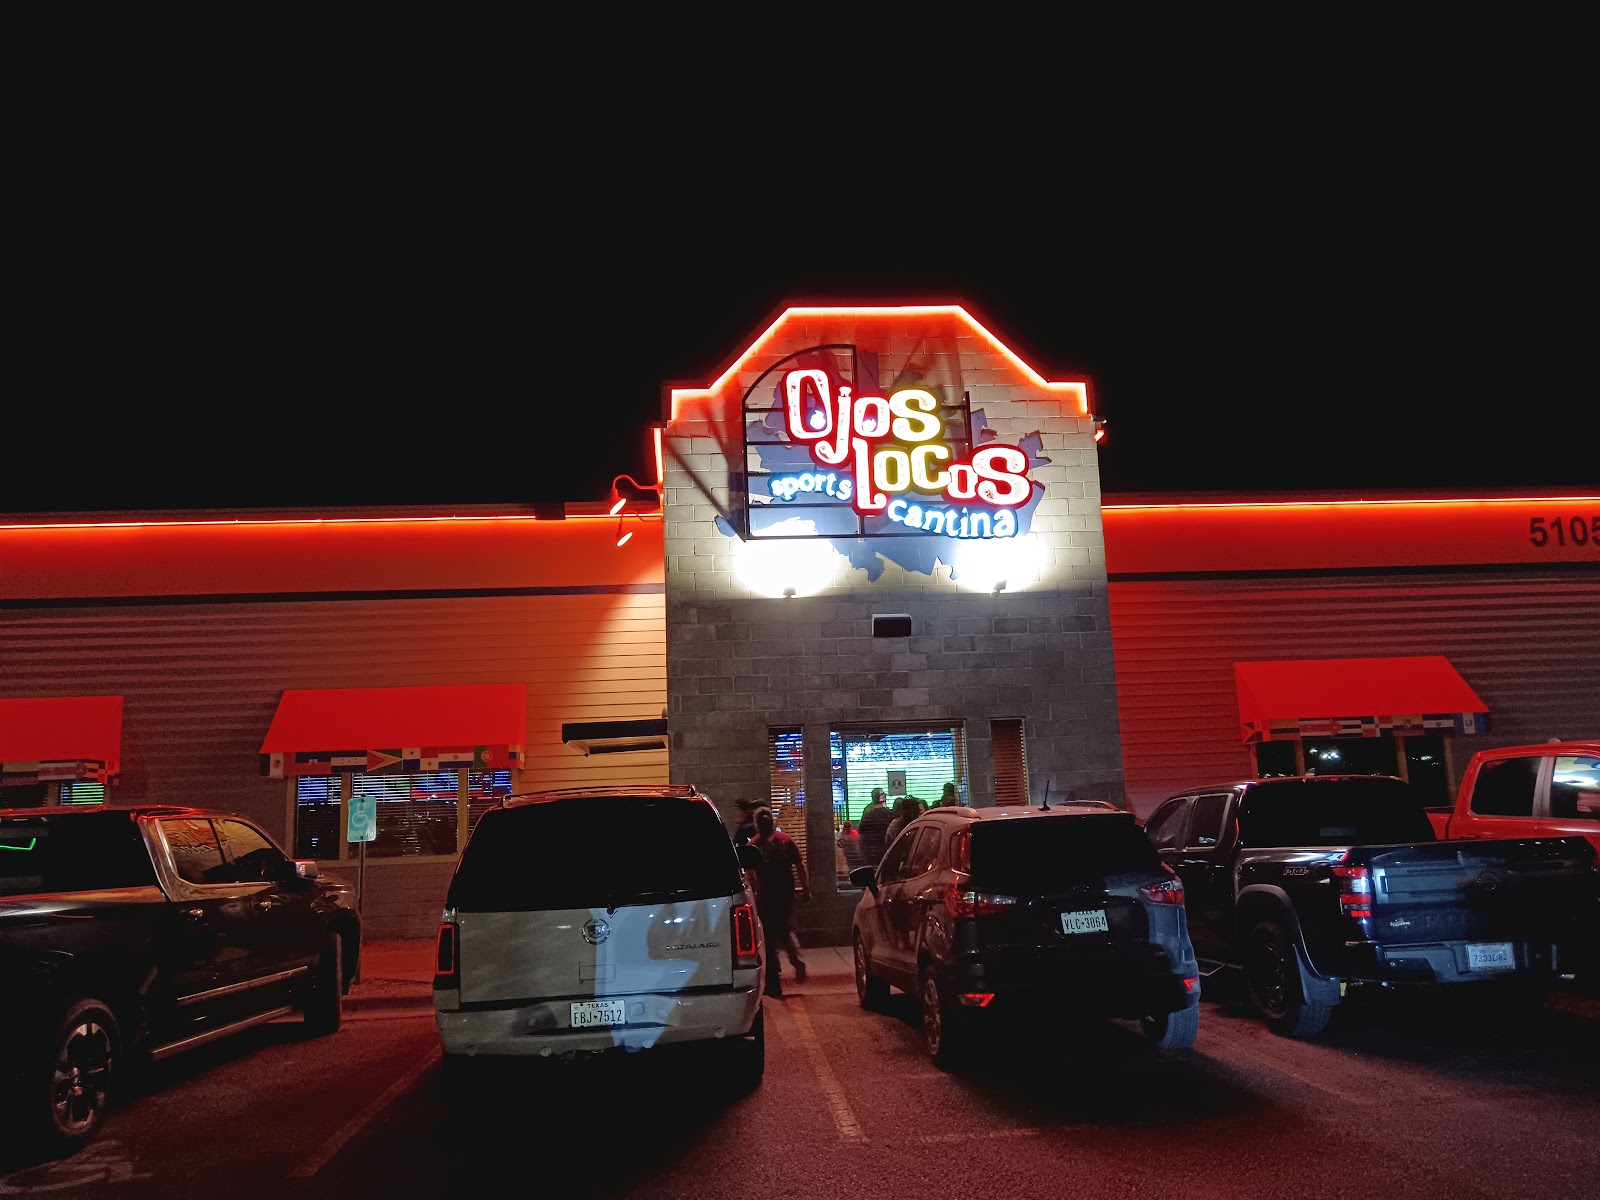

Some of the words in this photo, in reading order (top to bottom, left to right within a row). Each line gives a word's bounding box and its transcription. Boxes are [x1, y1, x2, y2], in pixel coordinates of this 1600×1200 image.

[785, 368, 941, 464] Ojos
[770, 472, 853, 501] sports
[851, 437, 1031, 510] Locos
[887, 499, 1016, 538] cantina
